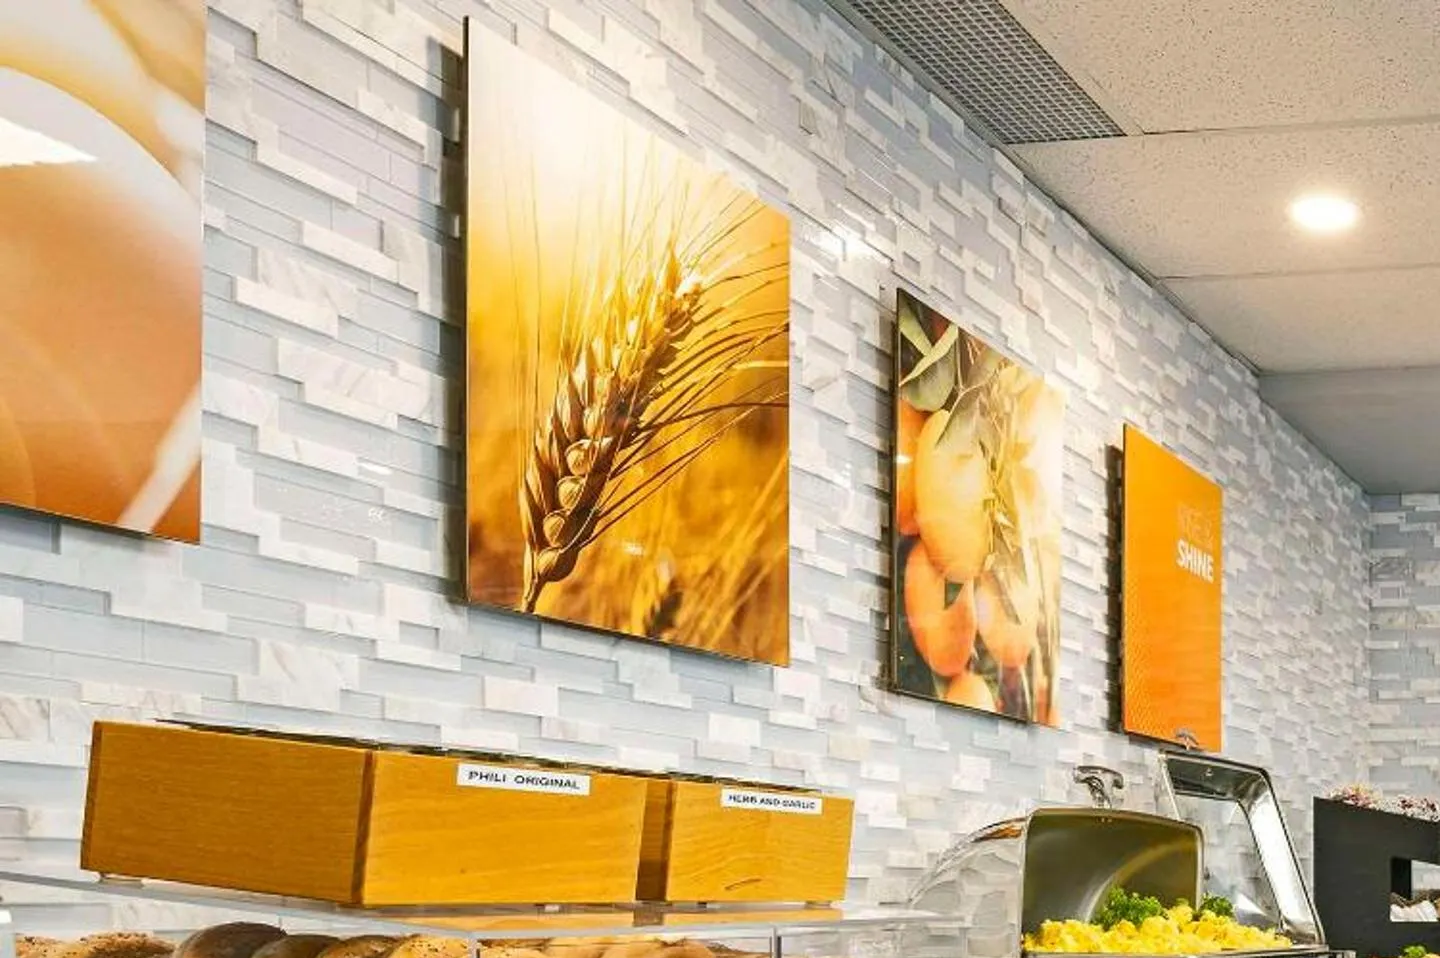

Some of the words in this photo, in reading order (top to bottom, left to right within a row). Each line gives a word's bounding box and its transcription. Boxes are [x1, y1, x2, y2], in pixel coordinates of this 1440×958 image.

[1175, 538, 1215, 584] SHINE
[467, 769, 507, 783] PHILI
[514, 774, 581, 790] ORIGINAL
[728, 794, 758, 804] HERB
[759, 797, 781, 806] AND
